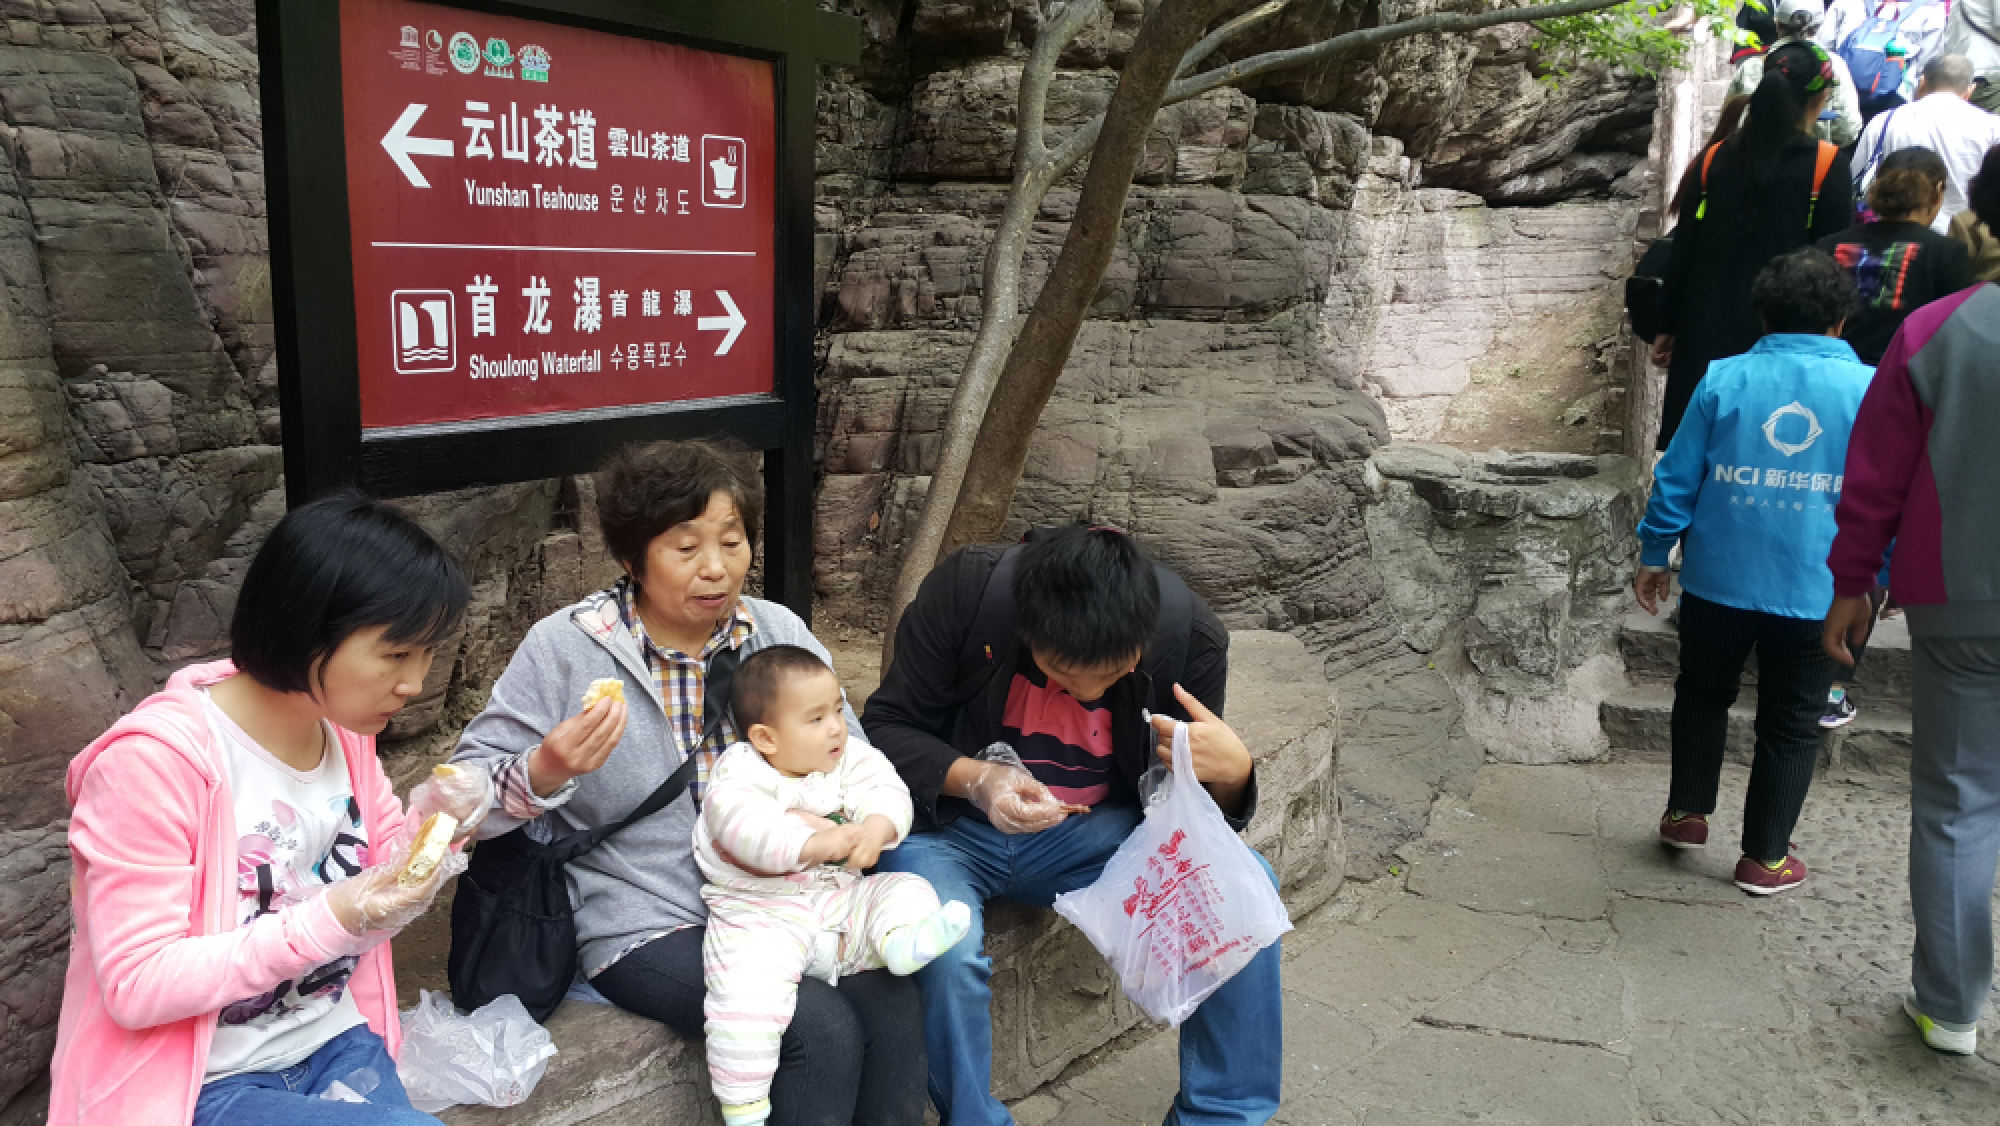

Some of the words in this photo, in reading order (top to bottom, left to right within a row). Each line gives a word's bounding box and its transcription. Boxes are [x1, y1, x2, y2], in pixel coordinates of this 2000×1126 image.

[462, 100, 598, 170] 云山茶道
[608, 127, 691, 163] 雲山茶道
[465, 178, 529, 208] Yunshan
[532, 183, 599, 212] Teahouse
[466, 274, 602, 338] 首龙瀑
[469, 353, 538, 381] Shoulong
[541, 350, 601, 375] Waterfall
[609, 341, 687, 371] 수용폭포수
[1715, 464, 1760, 486] NCI
